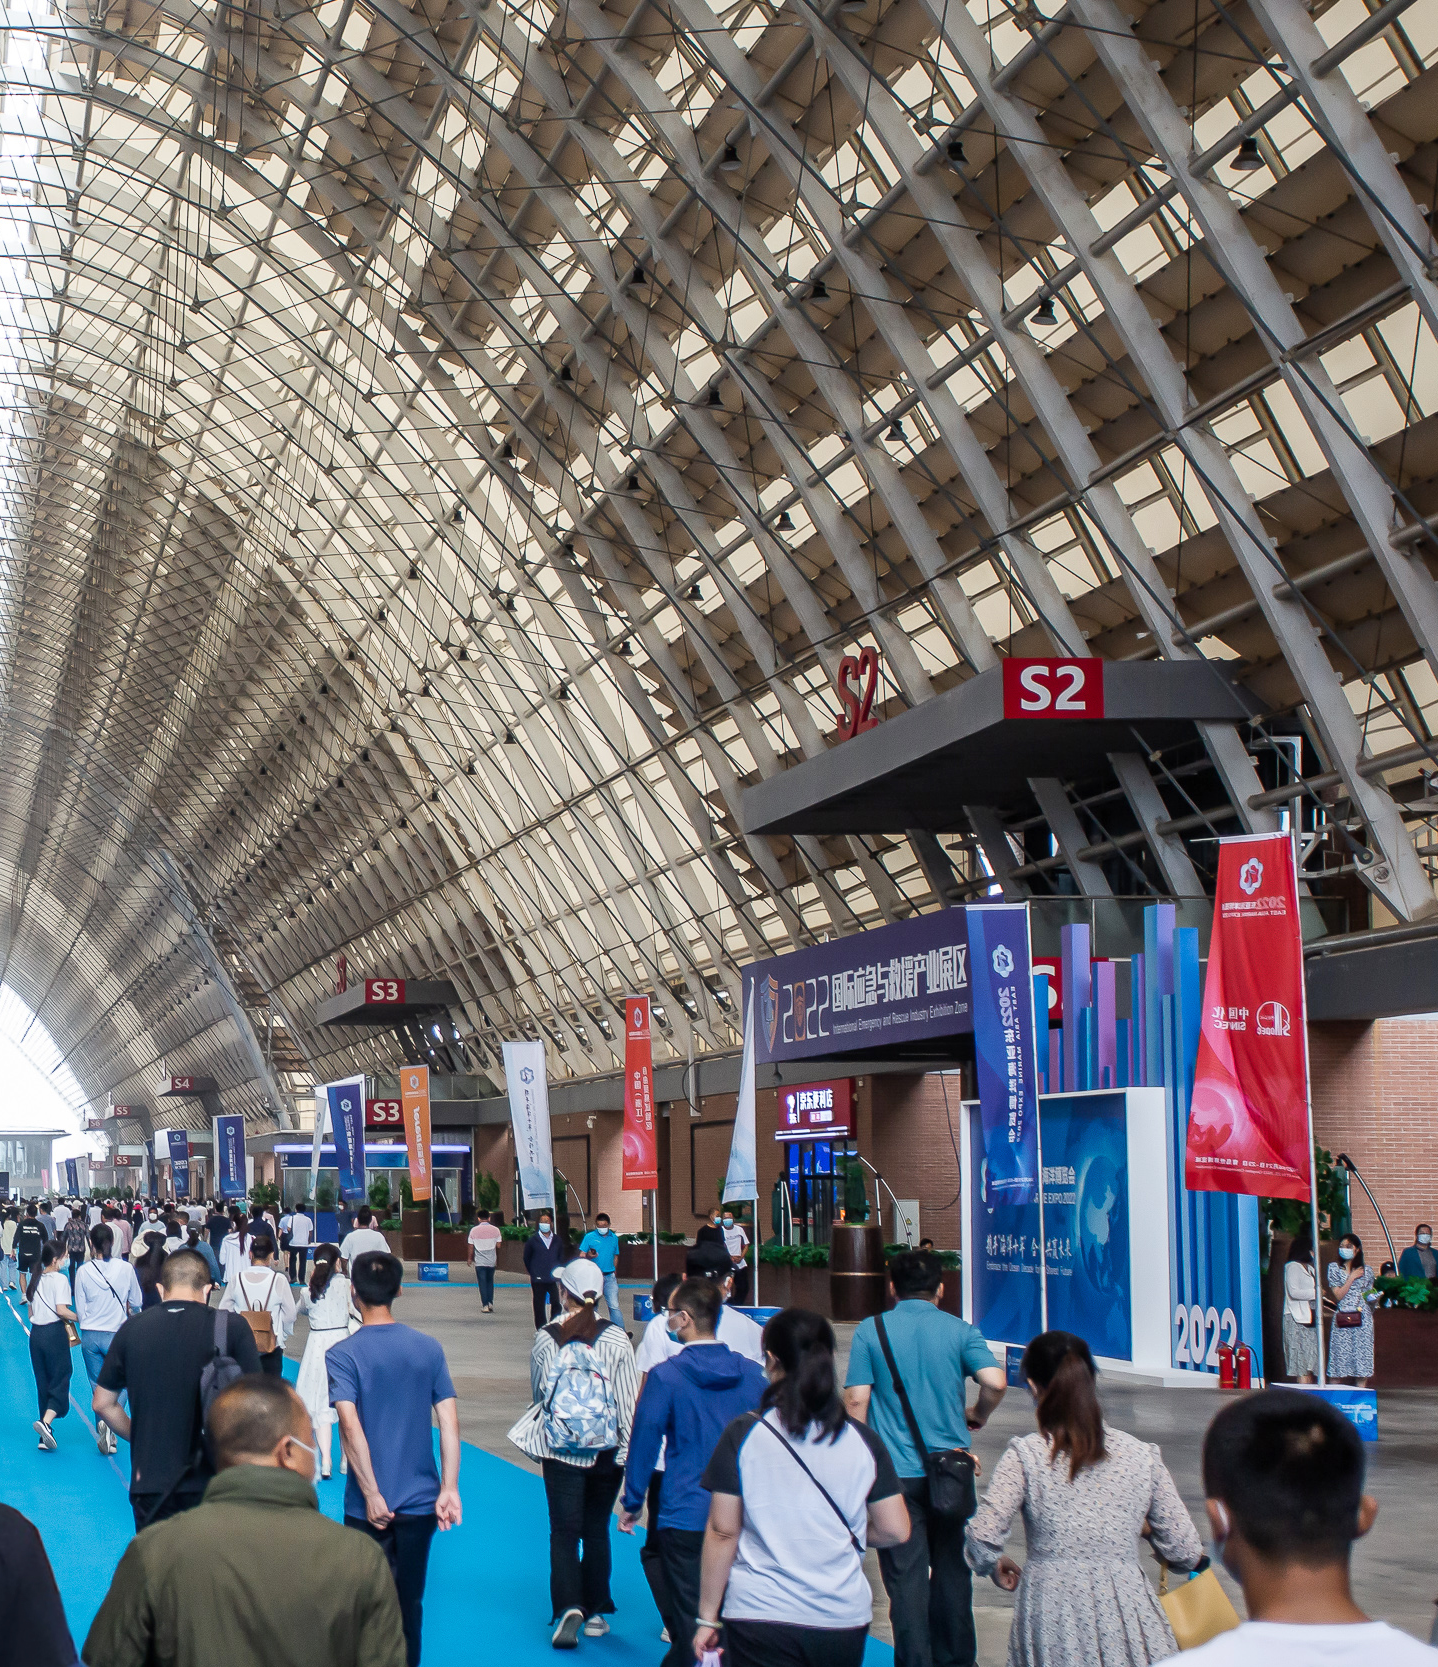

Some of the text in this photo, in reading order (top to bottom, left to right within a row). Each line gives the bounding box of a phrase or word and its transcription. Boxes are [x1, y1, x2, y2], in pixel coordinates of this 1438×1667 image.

[837, 646, 878, 742] S2
[1020, 666, 1086, 710] S2
[832, 943, 968, 1013] 国际应急与救援产业展区
[372, 982, 398, 1001] S3
[832, 1000, 968, 1035] International Emergency and Rescue Industry Exhibition Zone
[174, 1078, 190, 1089] S4
[116, 1107, 128, 1115] S5
[800, 1088, 834, 1111] 京东便利店
[373, 1102, 400, 1121] S3
[116, 1157, 128, 1165] S5
[1031, 1237, 1073, 1260] 合共赢未来
[1174, 1303, 1238, 1367] 2022
